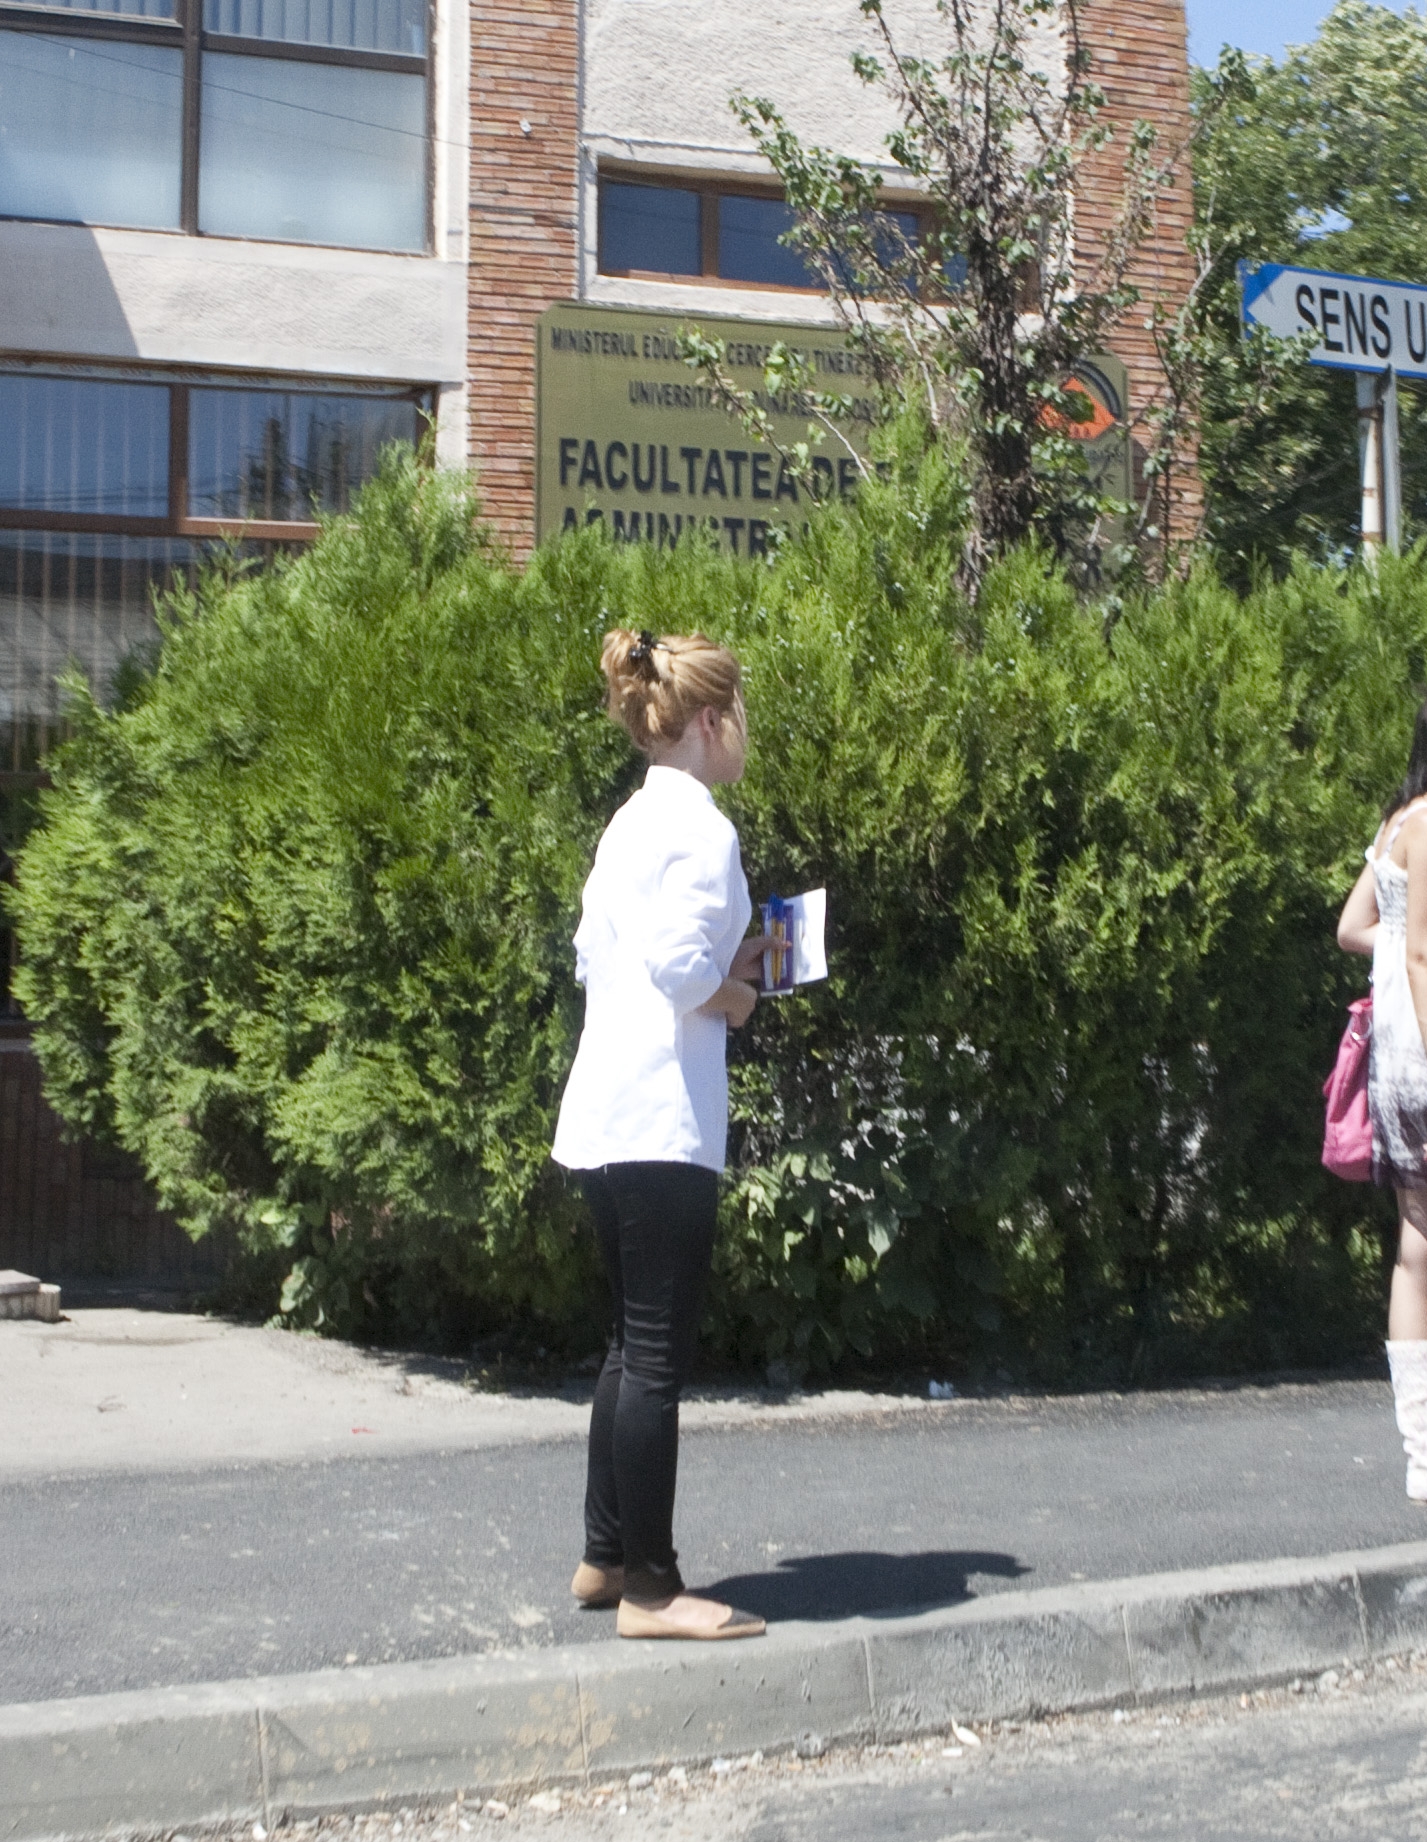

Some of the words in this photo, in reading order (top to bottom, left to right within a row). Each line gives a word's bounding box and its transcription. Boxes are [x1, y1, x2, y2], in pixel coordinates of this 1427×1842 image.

[551, 326, 638, 358] MINISTERUL
[1295, 283, 1391, 360] SENS
[559, 437, 800, 503] FACULTATEA
